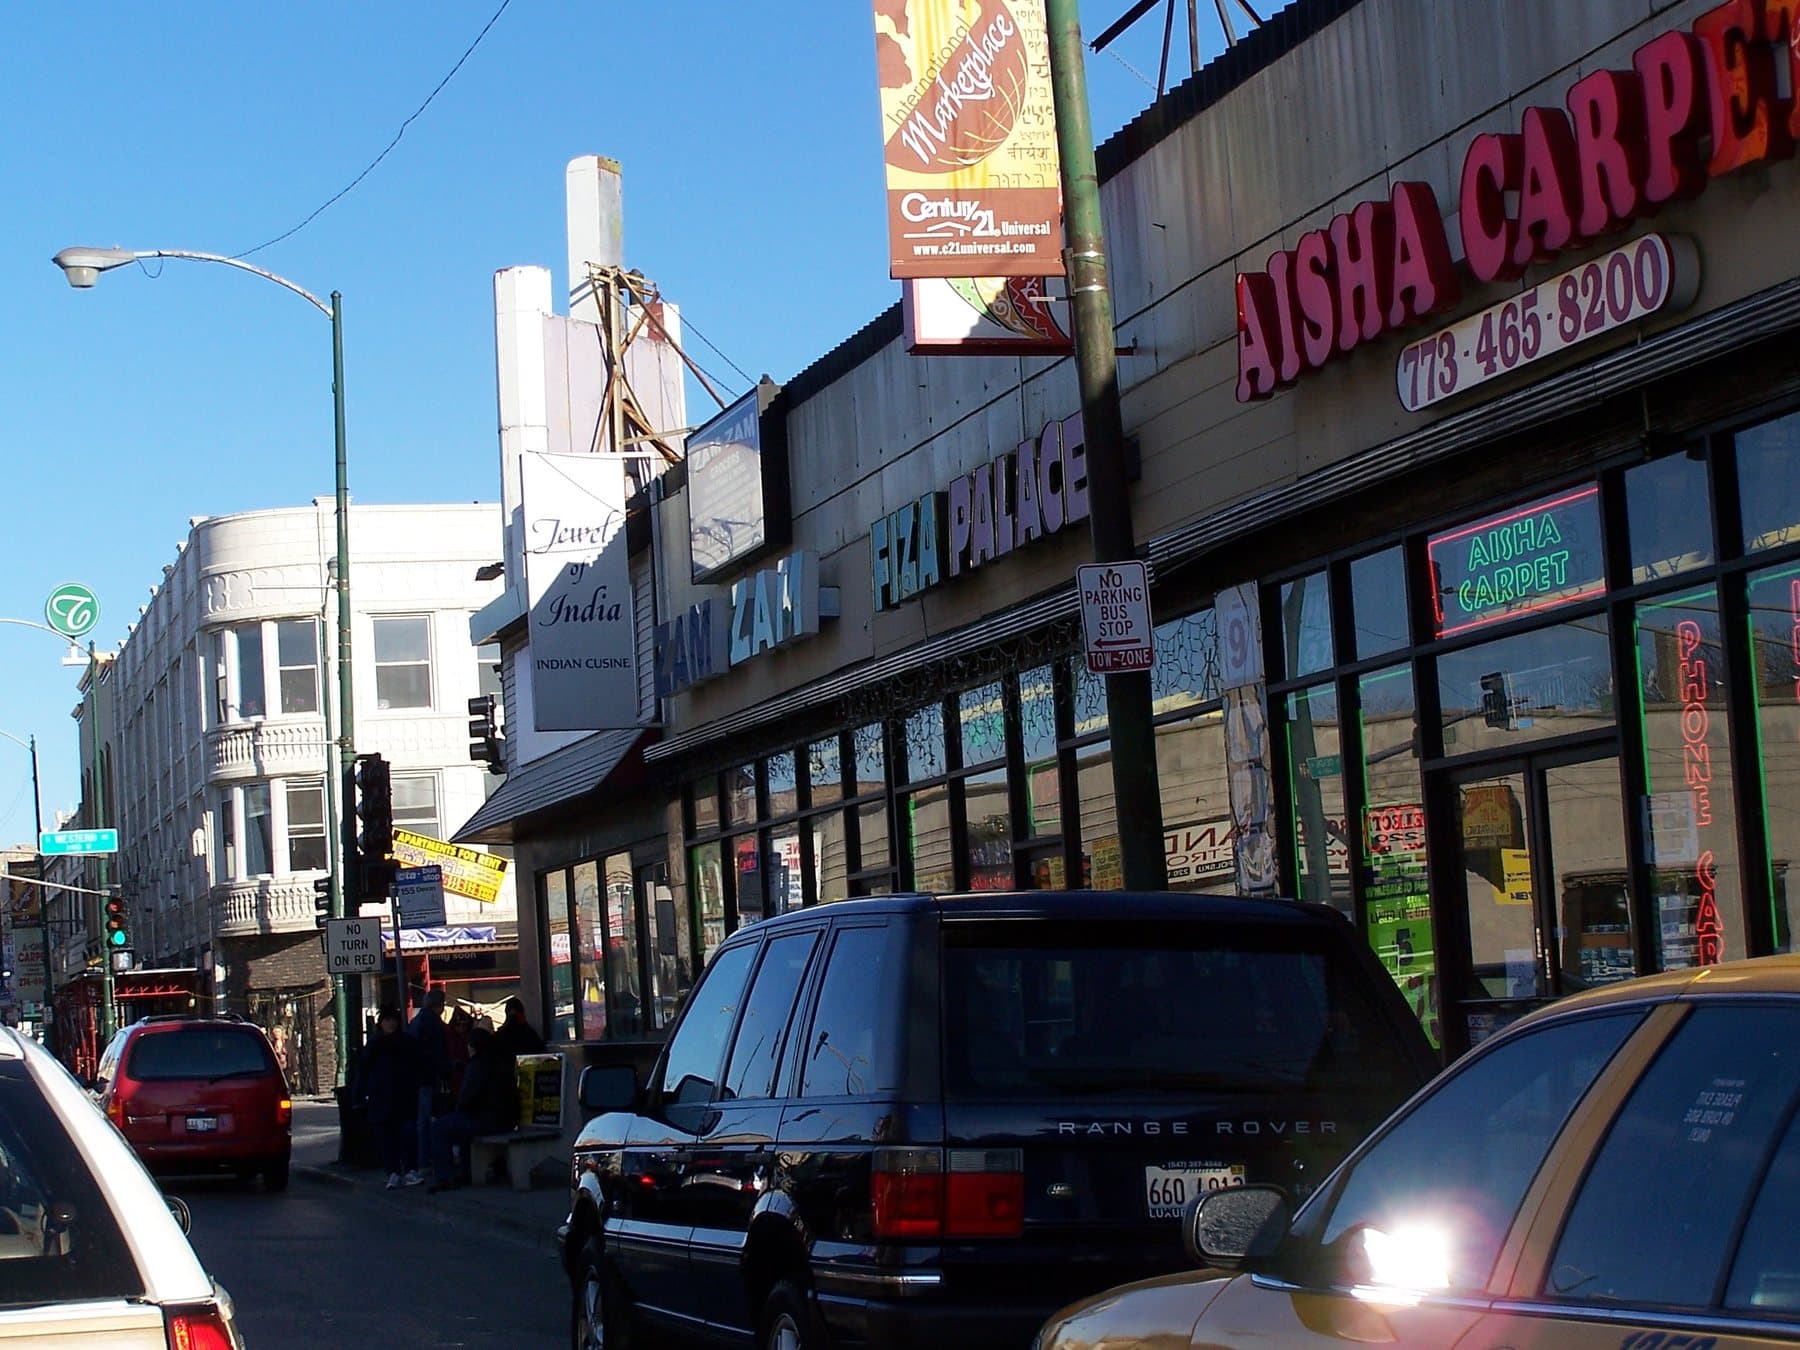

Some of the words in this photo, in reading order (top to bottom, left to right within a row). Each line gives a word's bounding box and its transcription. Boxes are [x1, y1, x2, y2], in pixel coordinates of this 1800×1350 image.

[886, 15, 972, 127] International
[902, 13, 1015, 165] Marketplace
[901, 192, 980, 222] Century
[1001, 220, 1051, 237] Universal
[912, 241, 1036, 257] www.c21universal.com
[1236, 181, 1452, 402] AISHA
[870, 491, 940, 613] FIZA
[949, 409, 1091, 577] PALACE
[532, 509, 620, 554] Jewel
[1469, 513, 1562, 572] AISHA
[570, 556, 591, 584] of
[1099, 573, 1123, 588] NO
[1459, 550, 1570, 612] CARPET
[539, 586, 622, 627] India
[1085, 587, 1143, 605] PARKING
[652, 599, 713, 699] ZAM
[729, 551, 804, 667] ZAM
[1100, 604, 1128, 620] BUS
[1099, 620, 1134, 637] STOP
[537, 659, 582, 670] INDIAN
[585, 657, 631, 669] CUSINE
[1677, 620, 1713, 827] PHONE
[396, 832, 458, 857] APARTMENTS
[457, 848, 478, 863] FOR
[477, 853, 502, 870] RENT
[401, 887, 415, 895] 155
[346, 924, 361, 935] NO
[341, 939, 369, 950] TURN
[335, 955, 349, 966] ON
[355, 954, 376, 966] RED
[1058, 1121, 1190, 1135] RANGE
[1216, 1121, 1338, 1135] ROVER
[1149, 1177, 1186, 1206] 660
